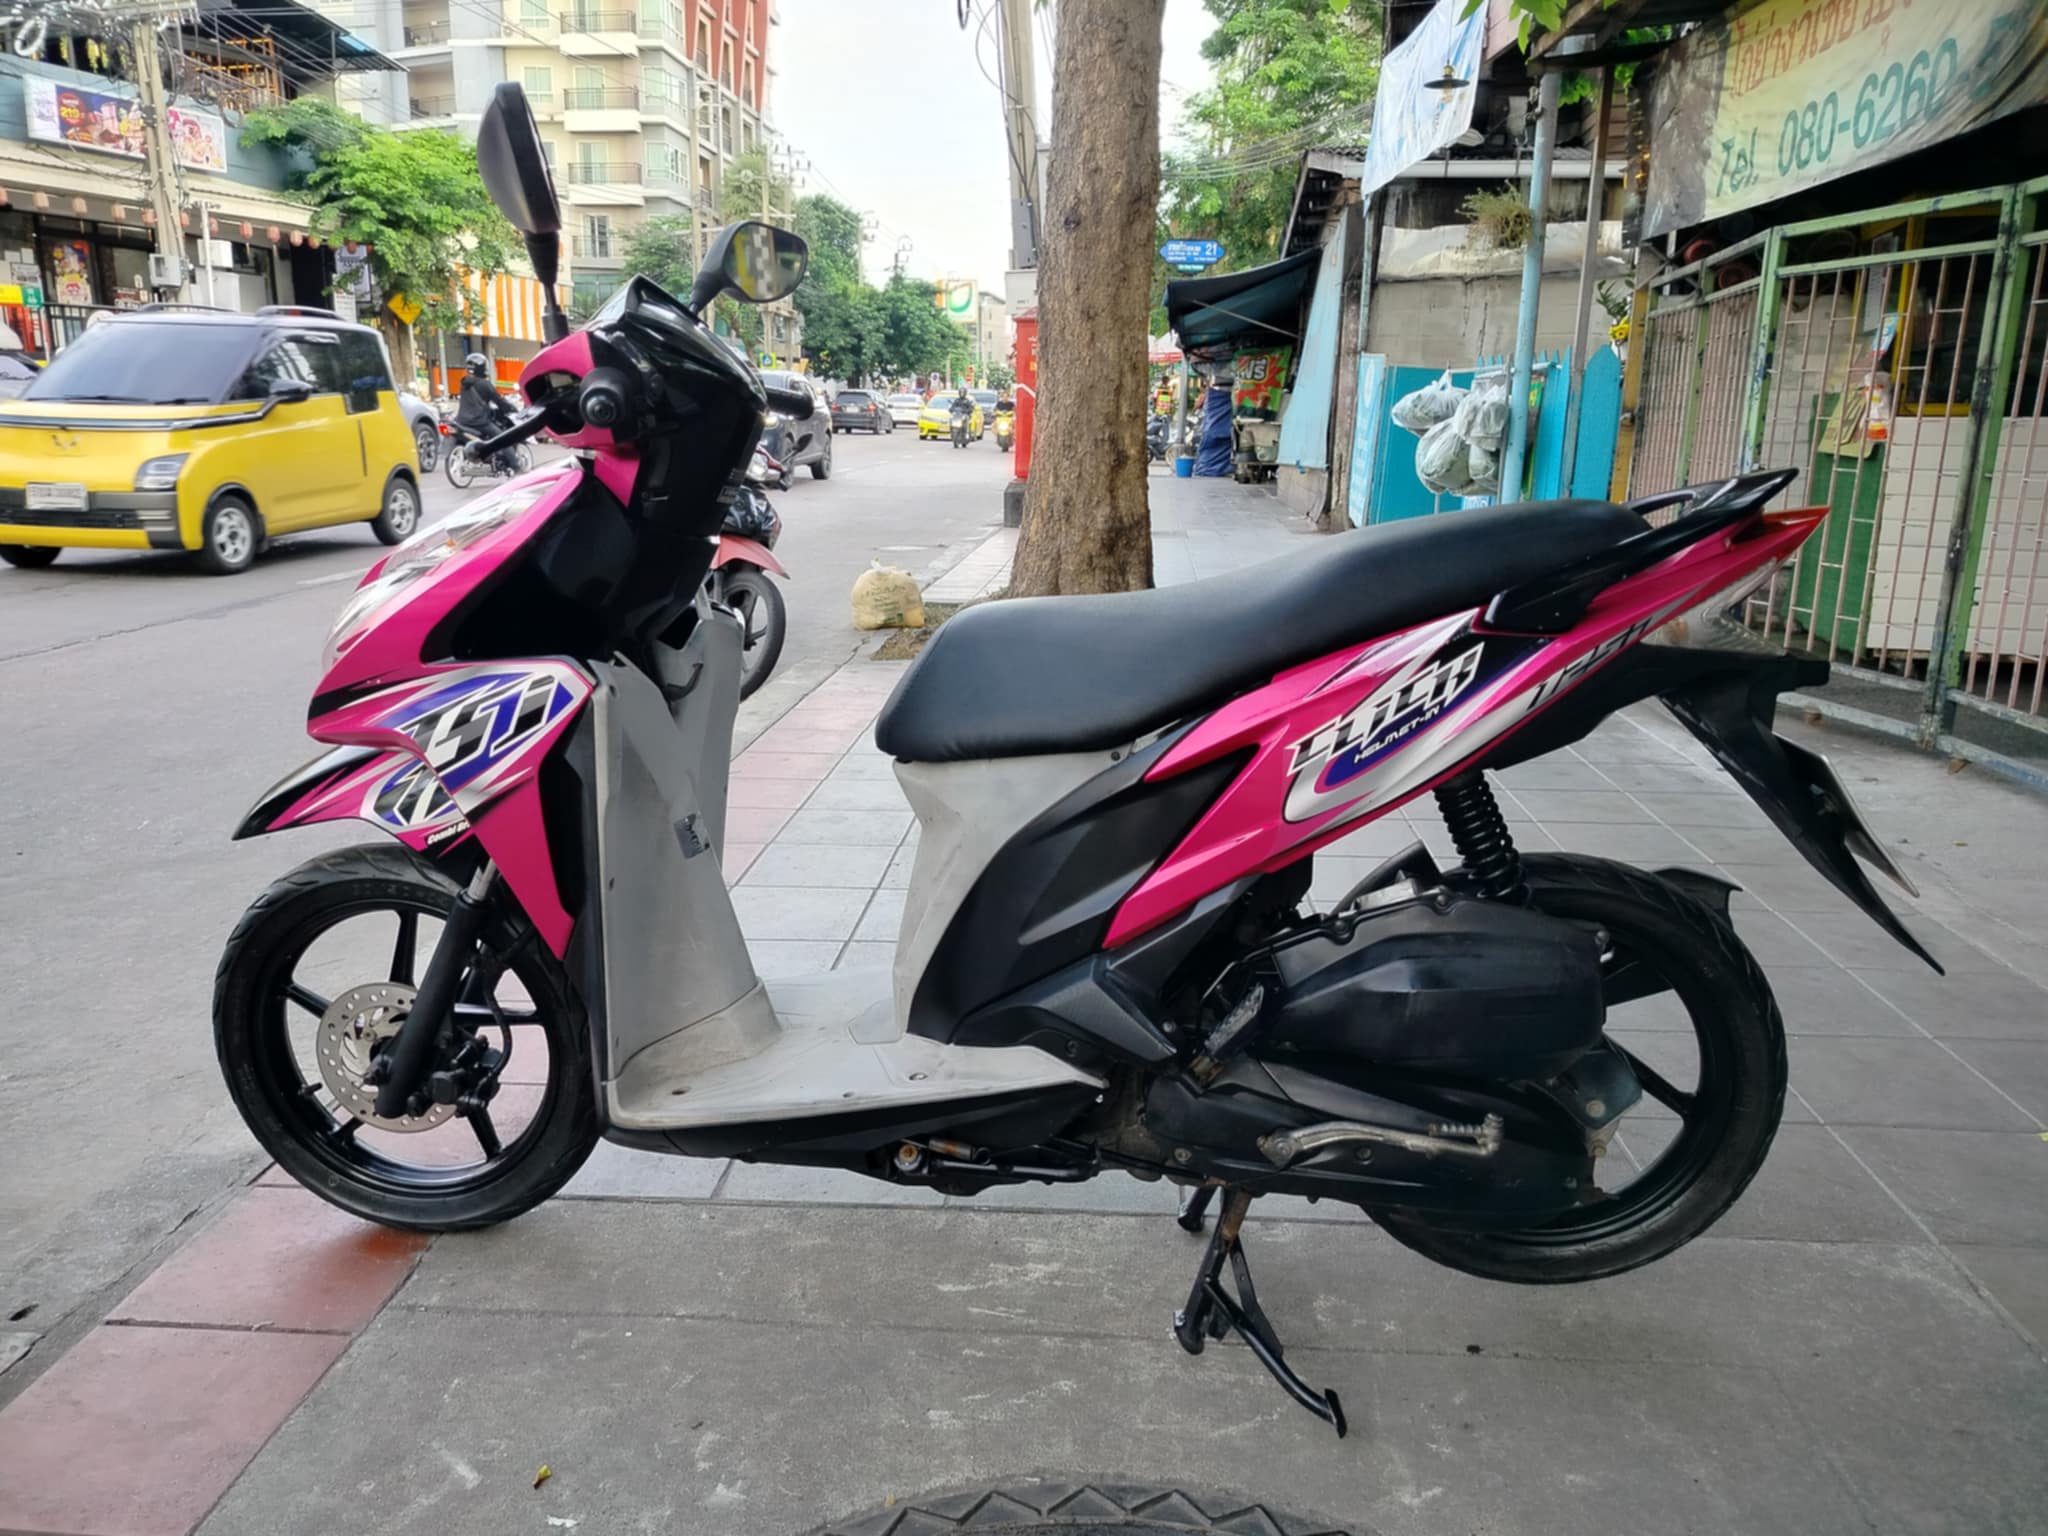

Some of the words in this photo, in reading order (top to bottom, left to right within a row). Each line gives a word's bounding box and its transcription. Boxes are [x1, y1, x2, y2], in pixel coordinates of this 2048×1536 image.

[1715, 126, 1760, 197] Tel.
[1205, 242, 1217, 256] 21
[1353, 706, 1440, 764] HELMET-IN
